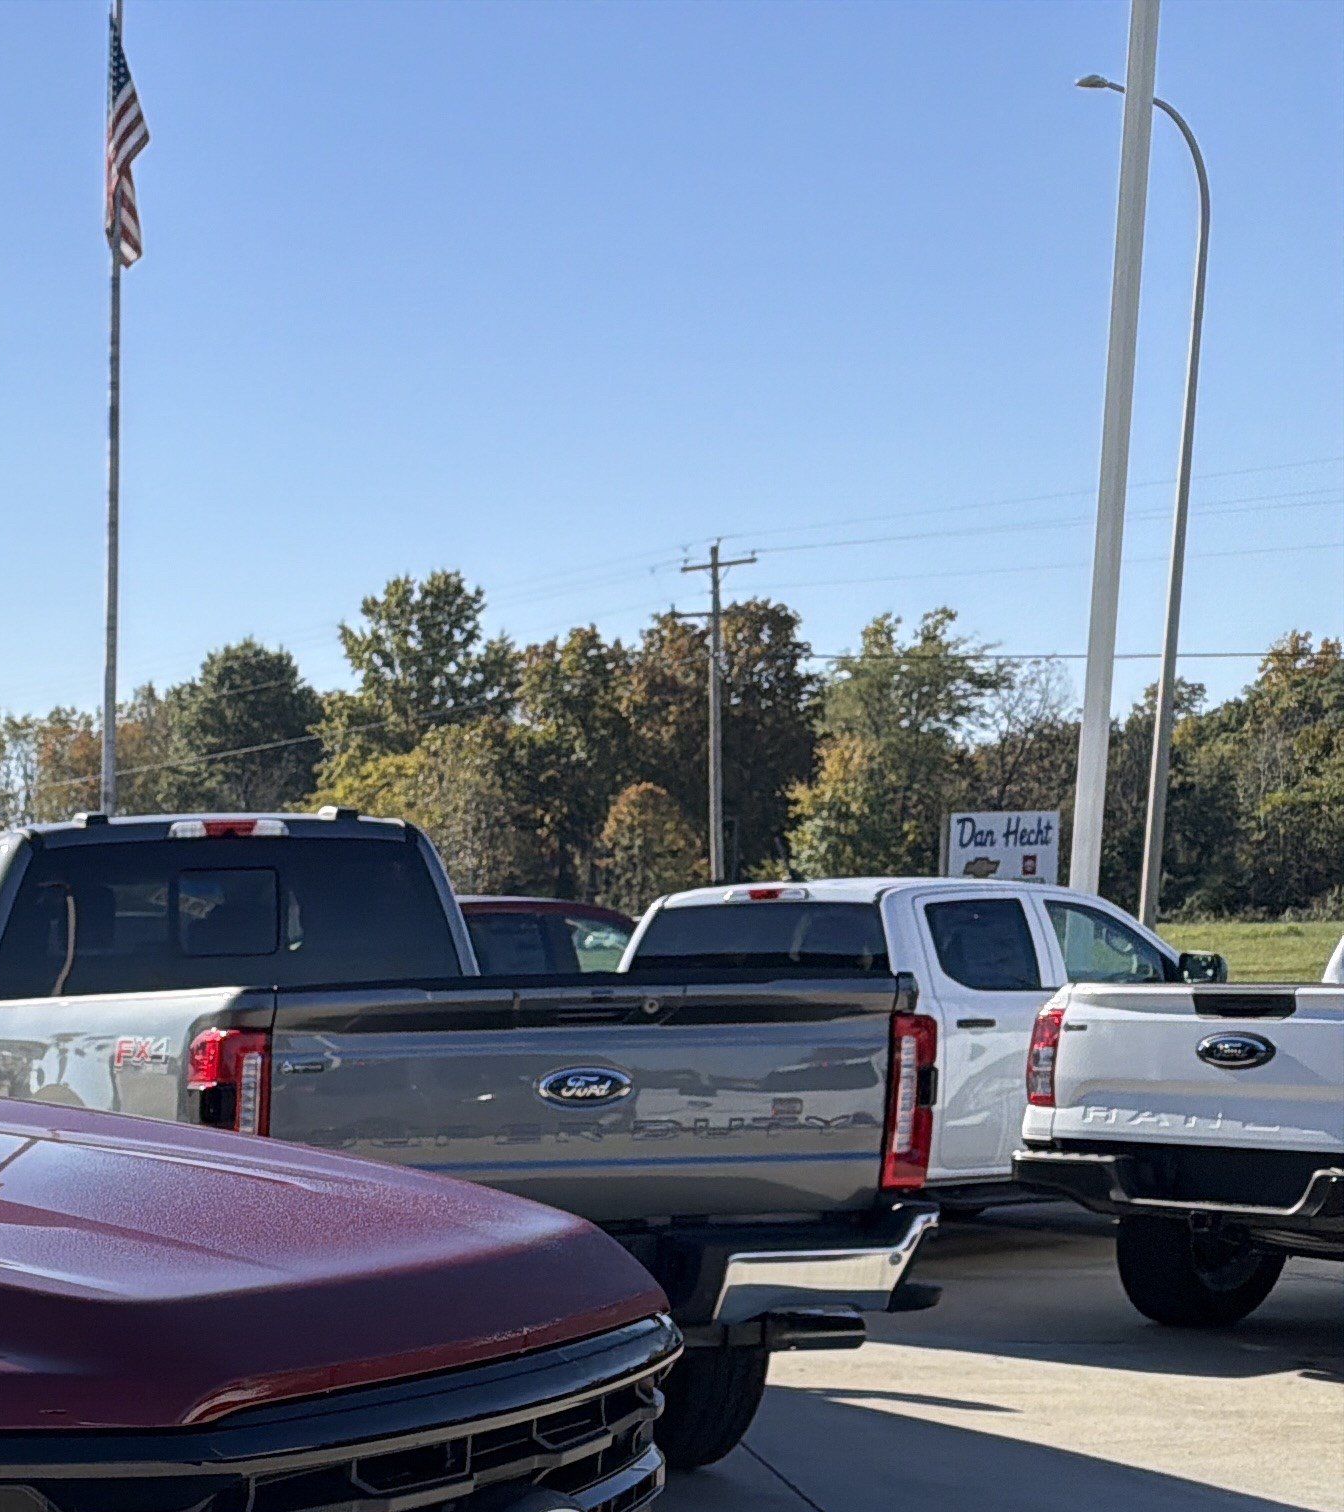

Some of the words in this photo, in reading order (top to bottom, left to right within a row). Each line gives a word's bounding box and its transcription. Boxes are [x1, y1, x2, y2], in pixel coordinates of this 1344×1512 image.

[956, 816, 997, 848] Dan
[1002, 815, 1053, 847] Hecht
[114, 1036, 170, 1067] FX4
[561, 1074, 611, 1098] Ford
